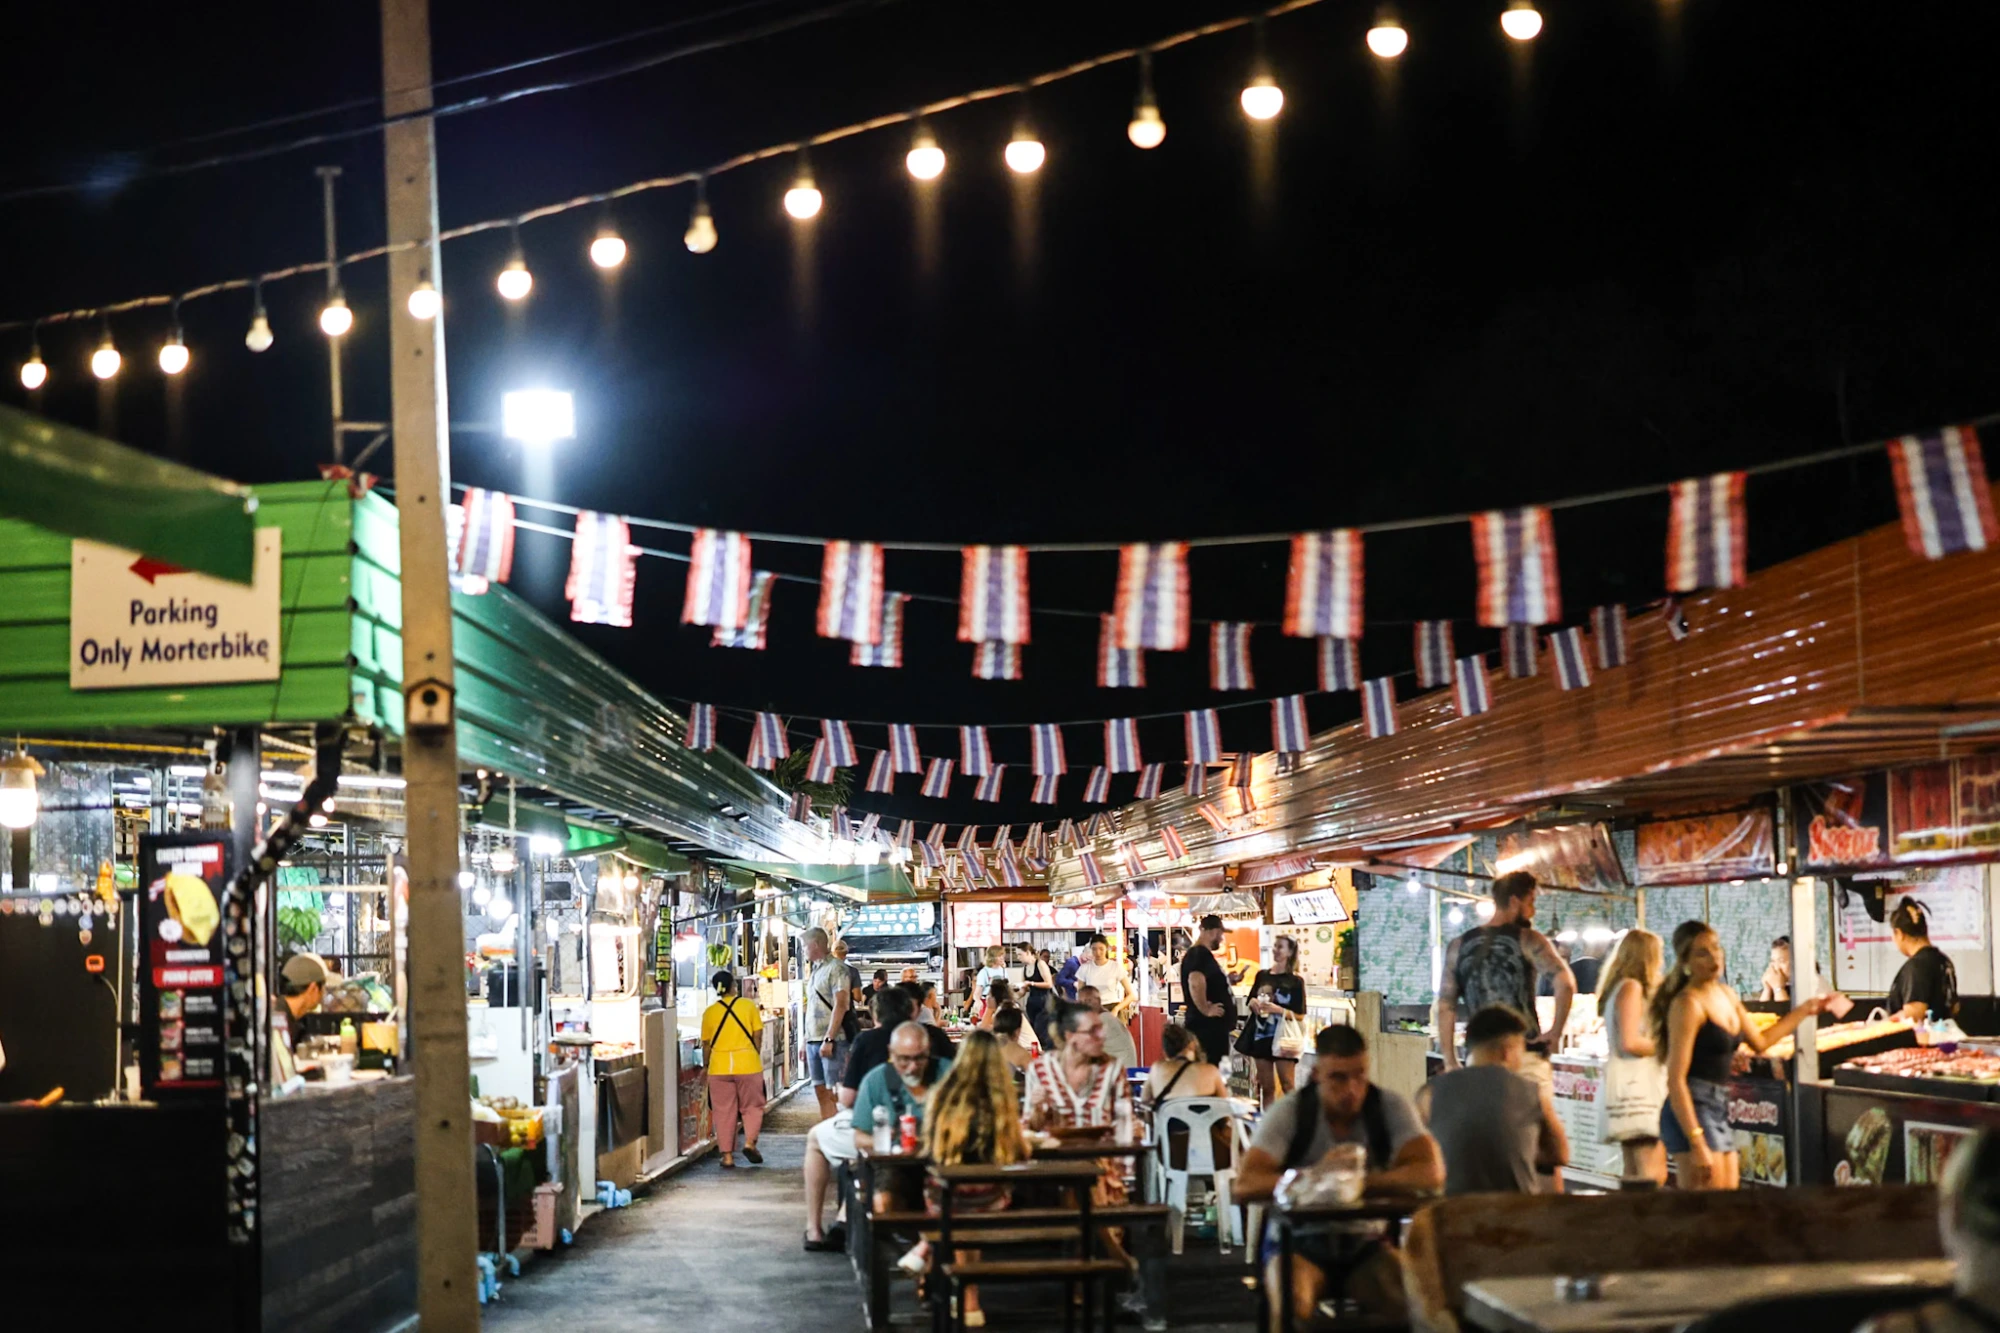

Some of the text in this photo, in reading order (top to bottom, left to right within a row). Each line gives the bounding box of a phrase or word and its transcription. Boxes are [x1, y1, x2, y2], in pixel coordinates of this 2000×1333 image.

[130, 597, 218, 629] Parking
[80, 632, 269, 671] Only Morterbike
